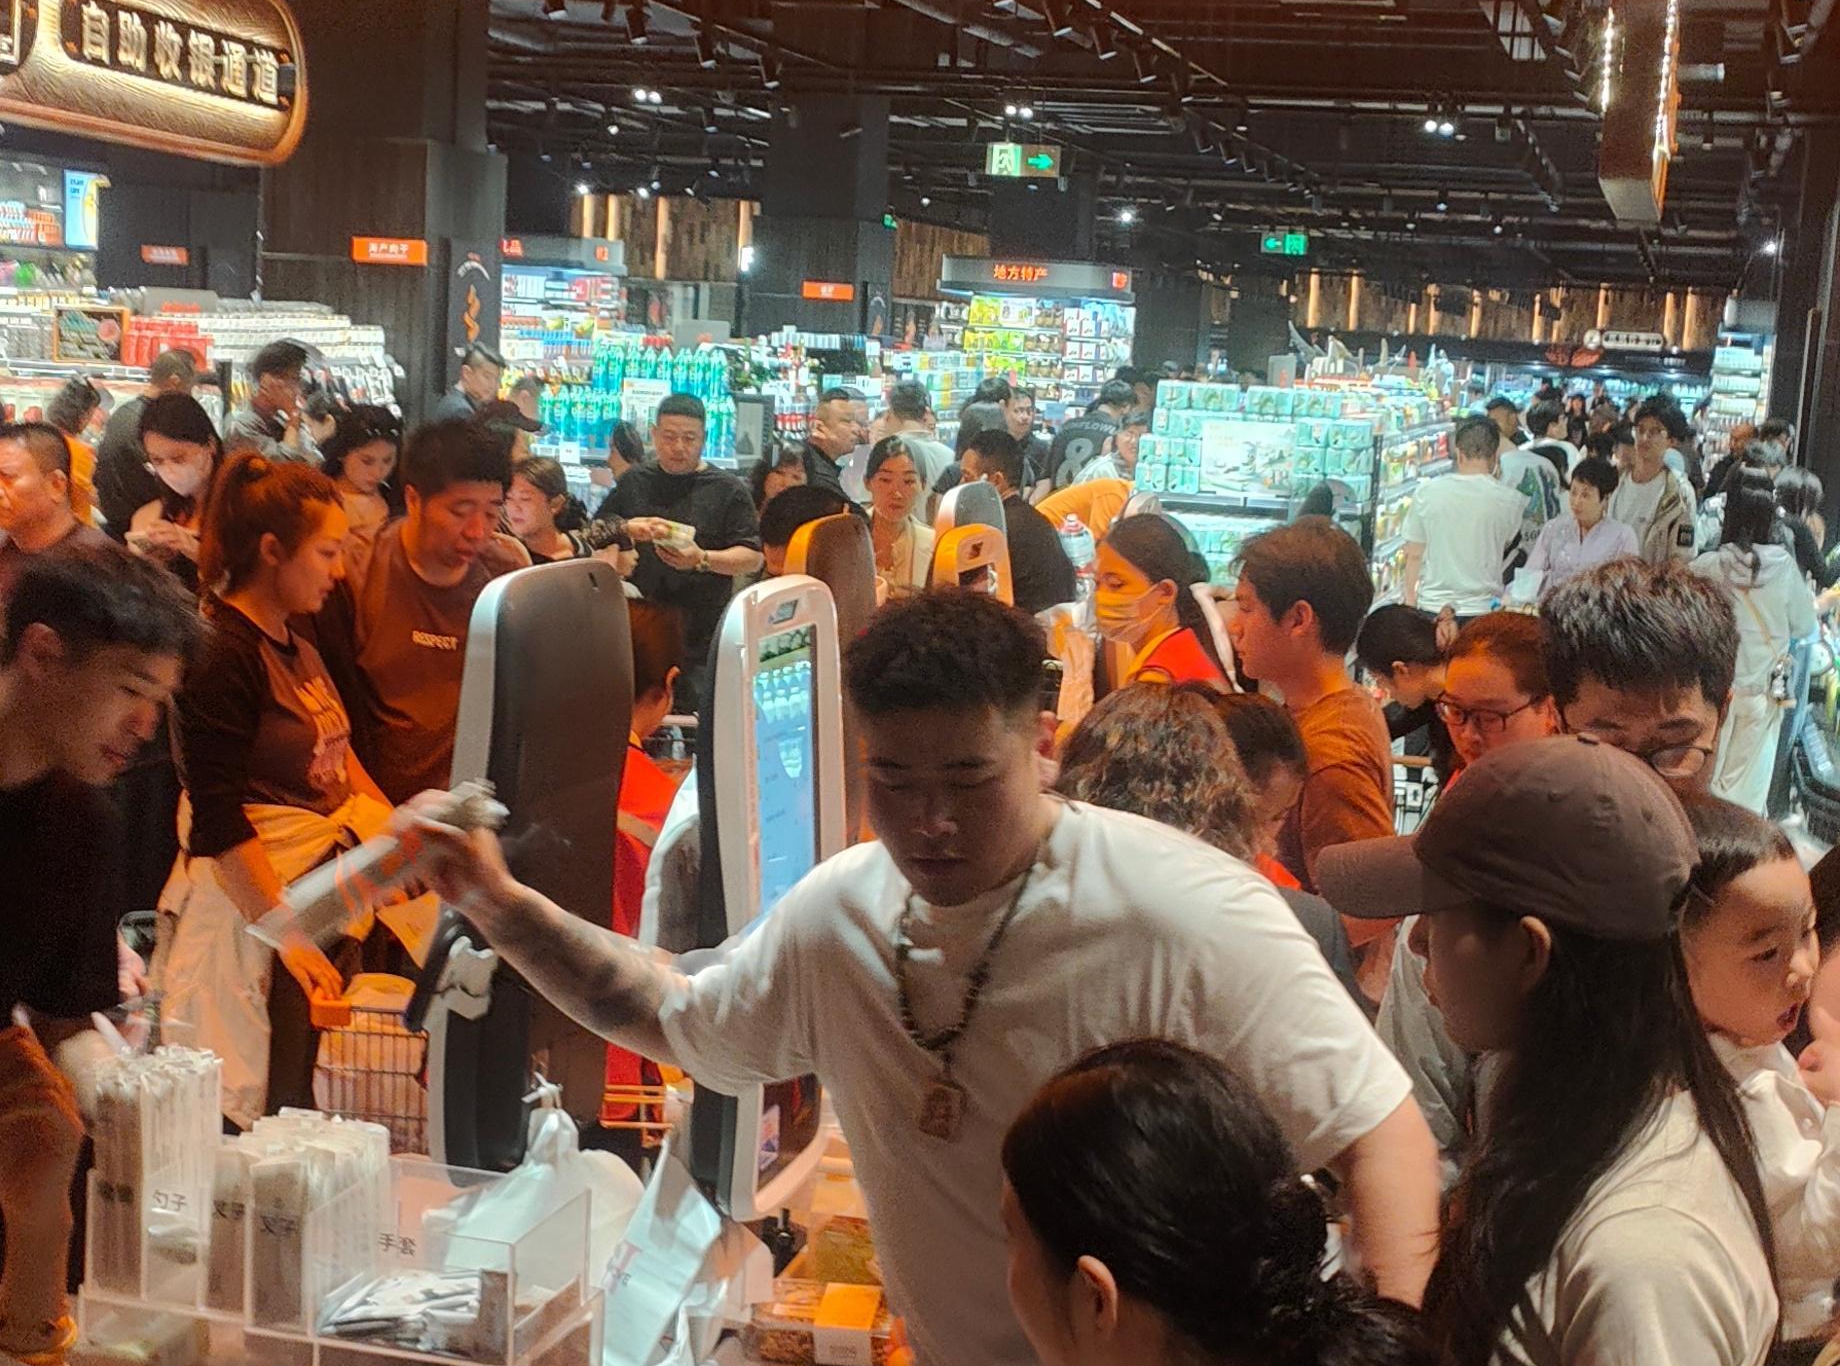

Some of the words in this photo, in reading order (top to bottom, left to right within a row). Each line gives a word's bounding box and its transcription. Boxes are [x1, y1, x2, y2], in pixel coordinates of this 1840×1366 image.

[81, 0, 280, 106] 自助收银通道
[993, 265, 1048, 281] 地方特产
[1056, 438, 1093, 488] 8
[153, 1190, 187, 1212] 勺子
[379, 1232, 417, 1257] 手套
